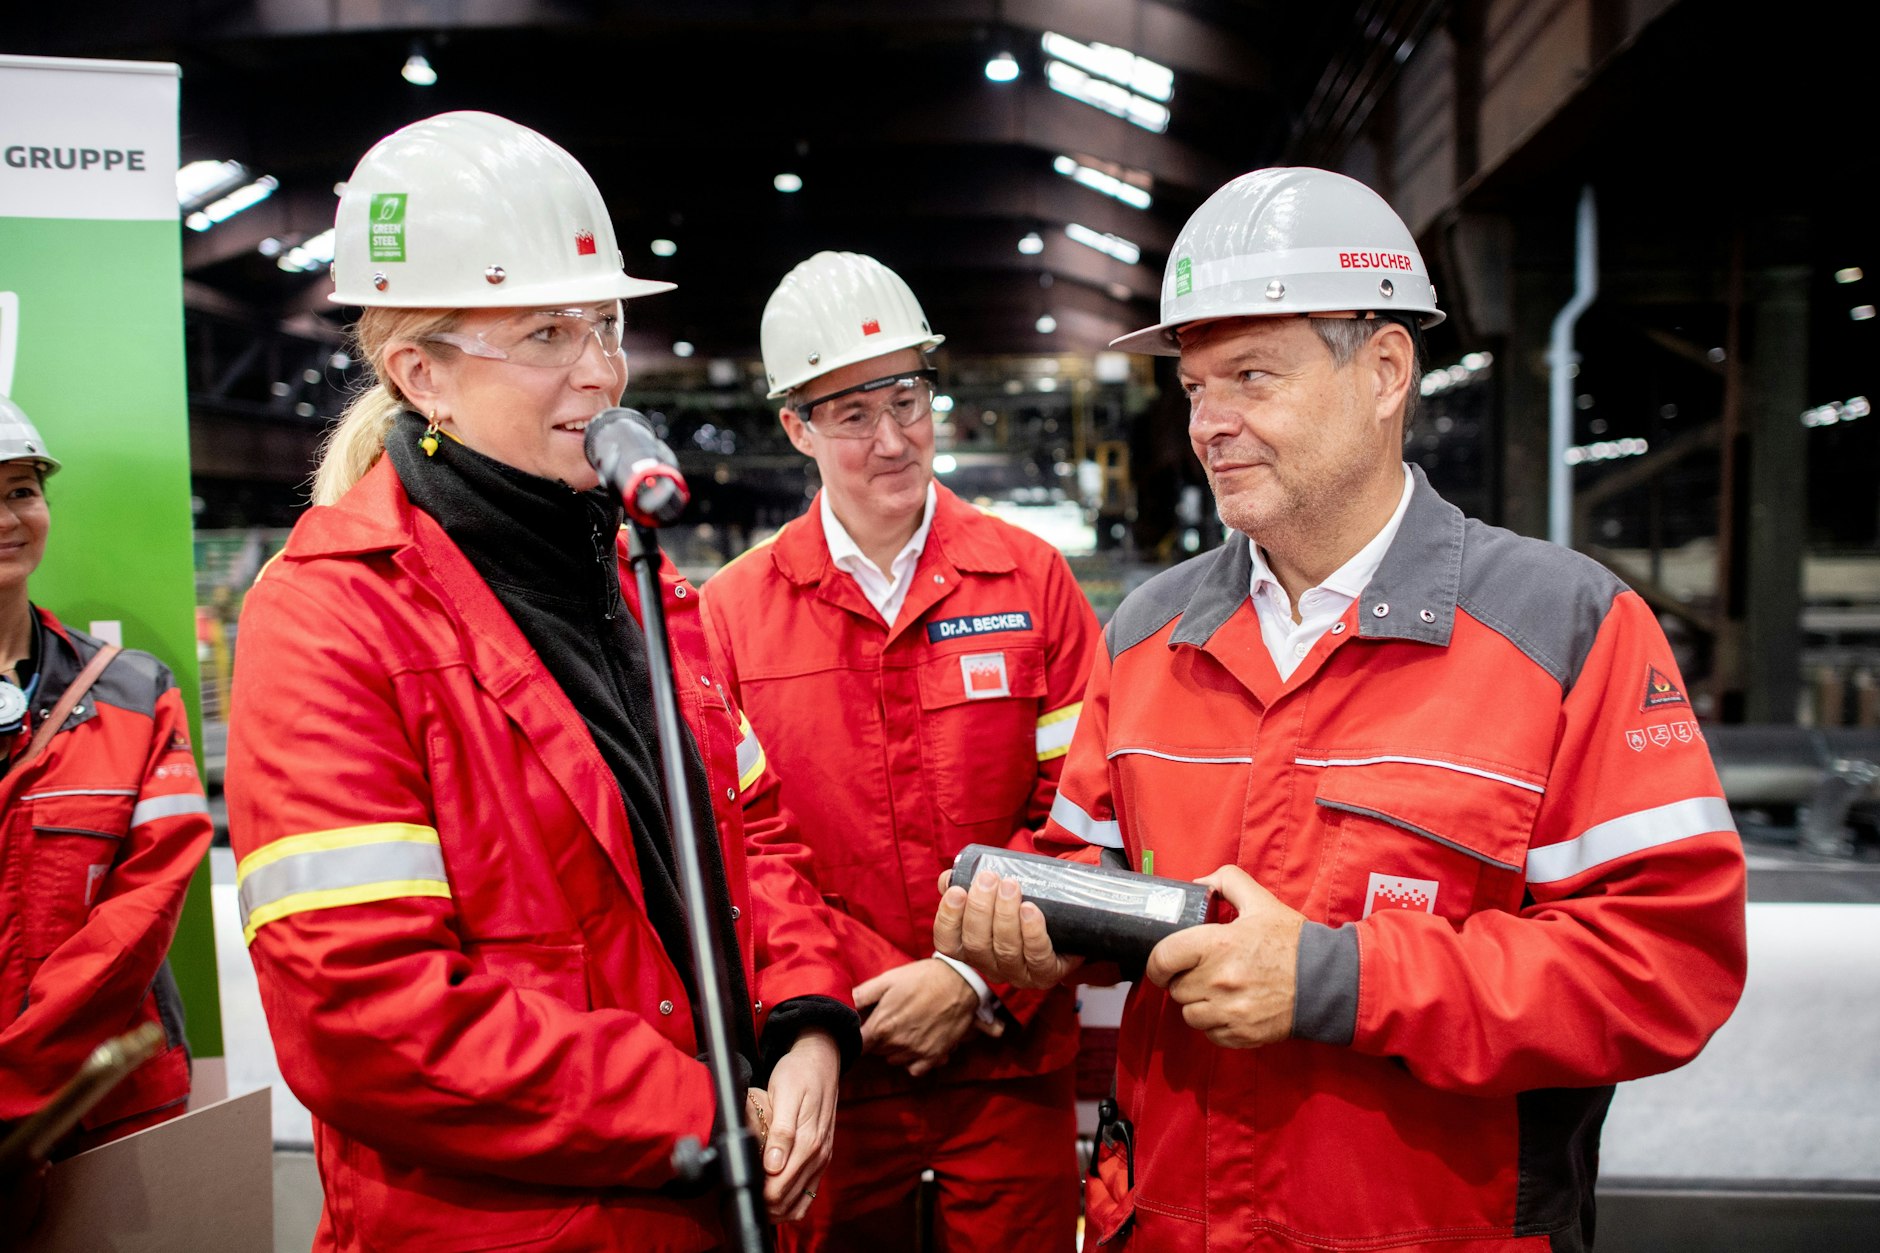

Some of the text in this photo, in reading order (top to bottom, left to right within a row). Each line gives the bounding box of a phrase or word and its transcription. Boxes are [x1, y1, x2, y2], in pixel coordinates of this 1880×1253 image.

[4, 145, 146, 171] GRUPPE
[373, 223, 401, 234] GREEN
[373, 235, 399, 247] STEEL
[1339, 252, 1413, 271] BESUCHER
[972, 613, 1027, 632] BECKER
